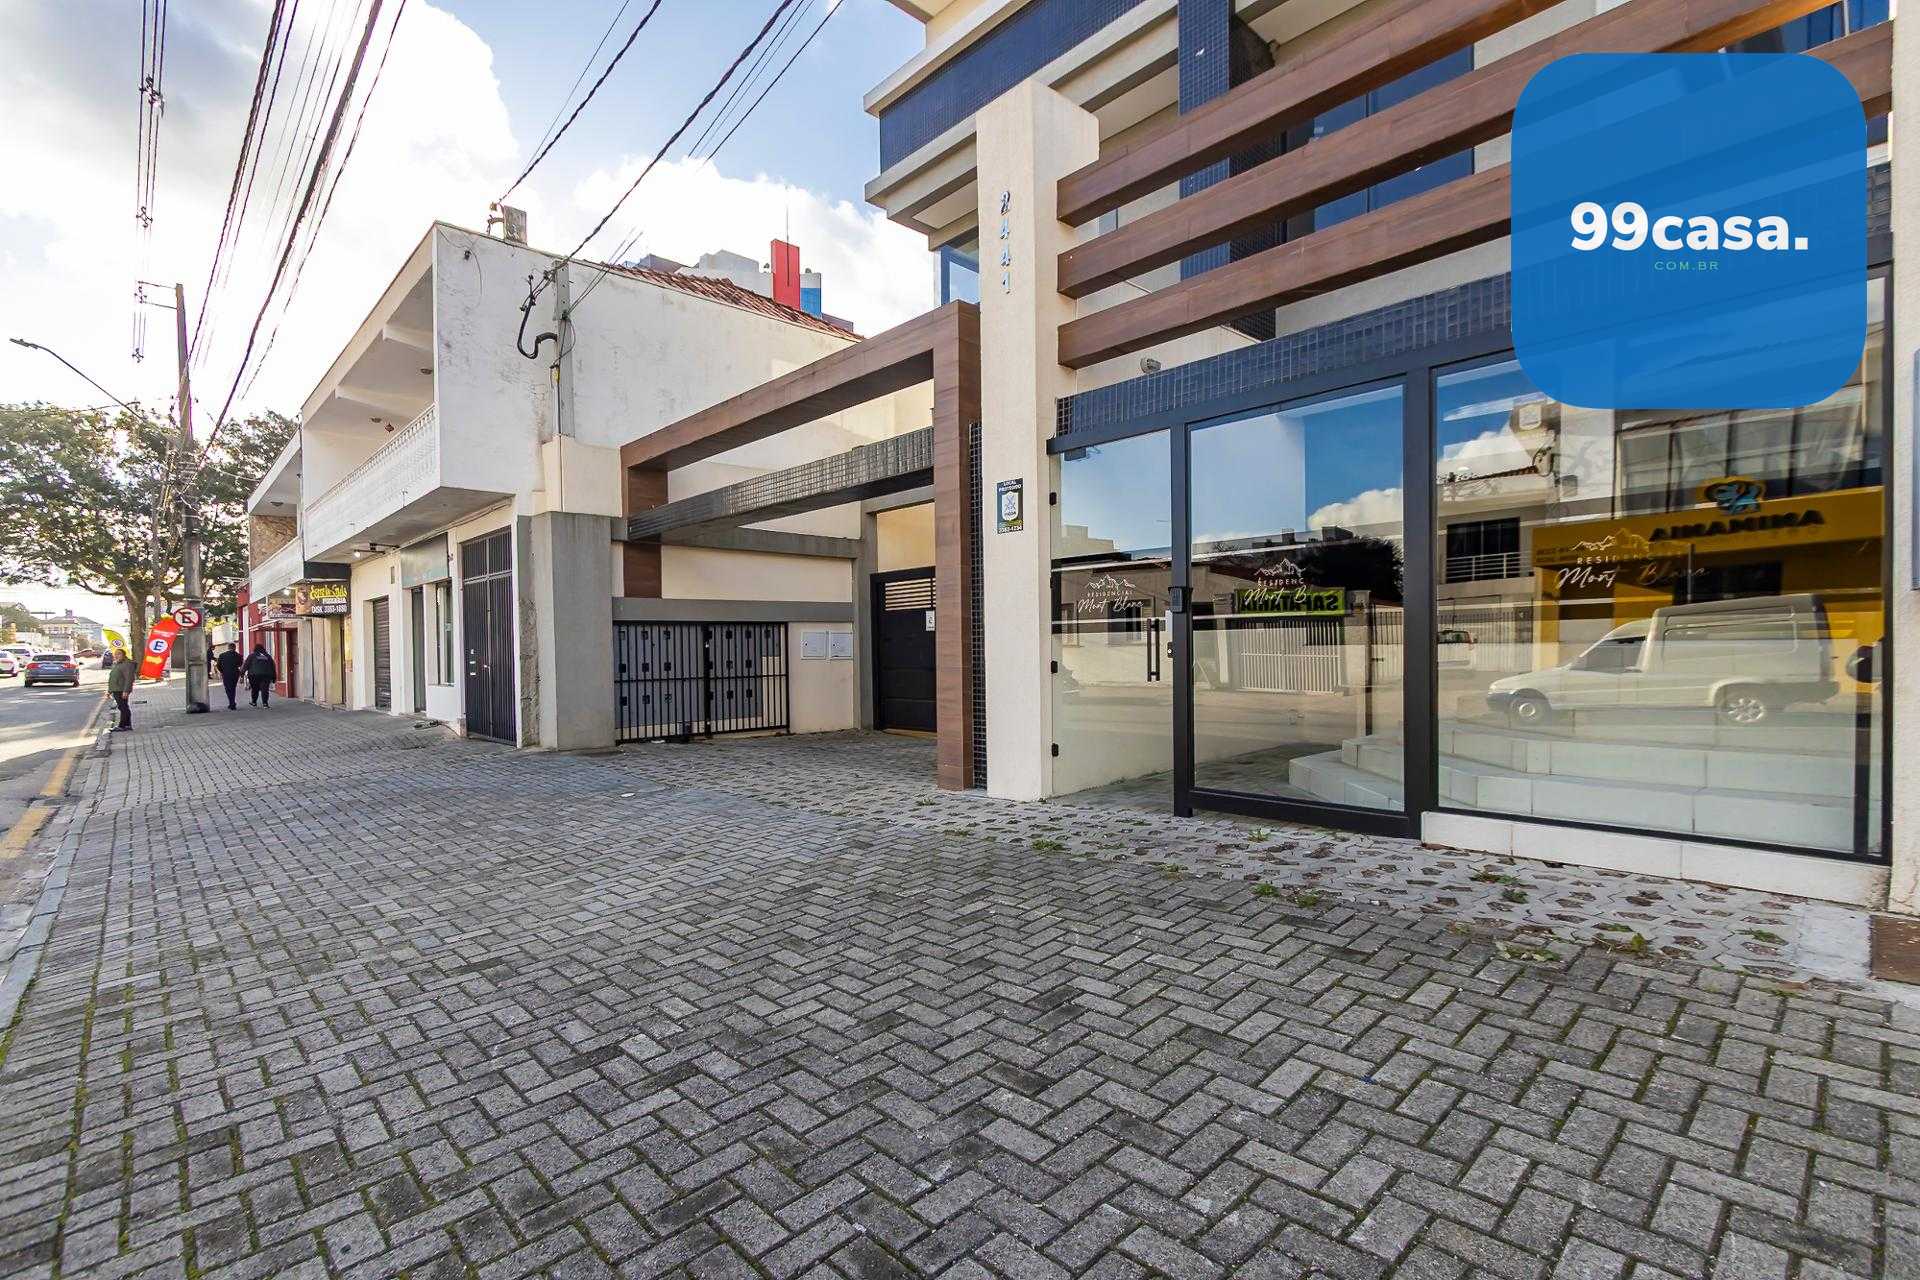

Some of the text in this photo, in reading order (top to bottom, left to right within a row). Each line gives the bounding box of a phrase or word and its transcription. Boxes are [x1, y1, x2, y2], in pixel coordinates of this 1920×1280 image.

[1257, 577, 1305, 587] RESIDENC
[311, 605, 323, 614] DISK
[1078, 596, 1144, 613] Mont Blanc
[153, 640, 164, 651] E
